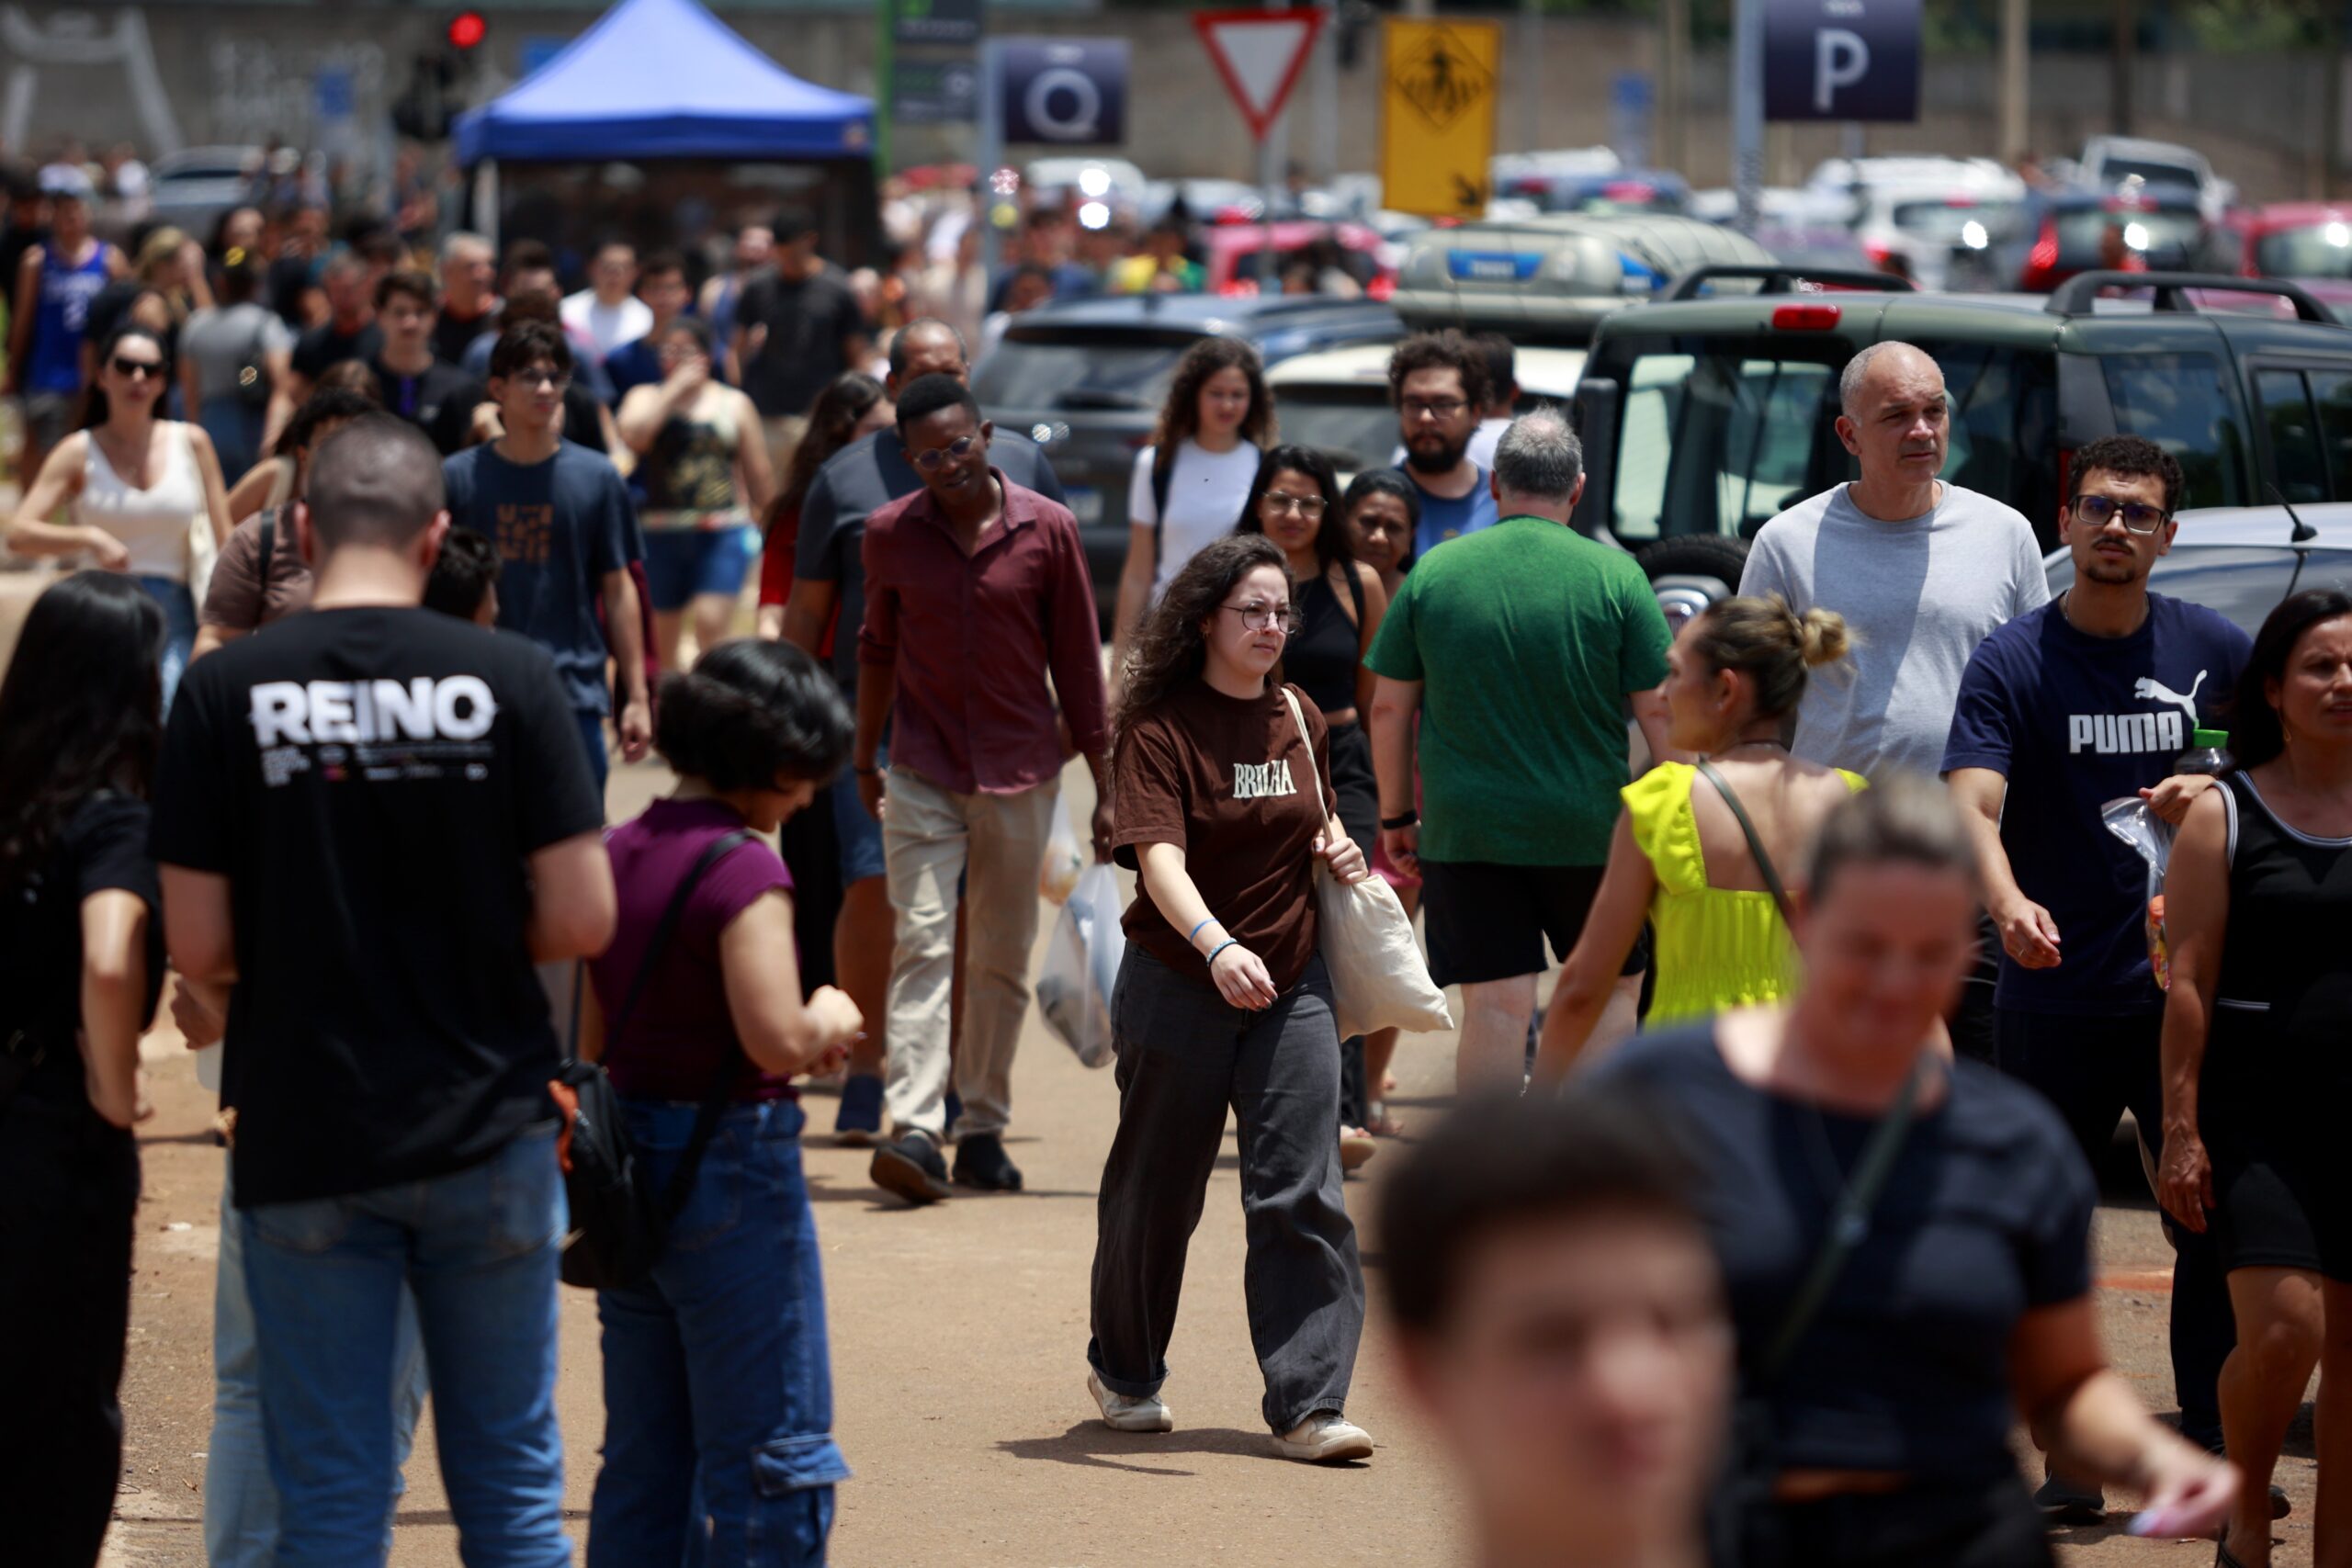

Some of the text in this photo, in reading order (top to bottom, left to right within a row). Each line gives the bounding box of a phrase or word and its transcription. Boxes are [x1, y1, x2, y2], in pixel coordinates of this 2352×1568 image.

[1024, 68, 1101, 139] Q
[1815, 28, 1870, 112] P
[250, 675, 496, 747] REINO
[2069, 710, 2183, 753] PUMA
